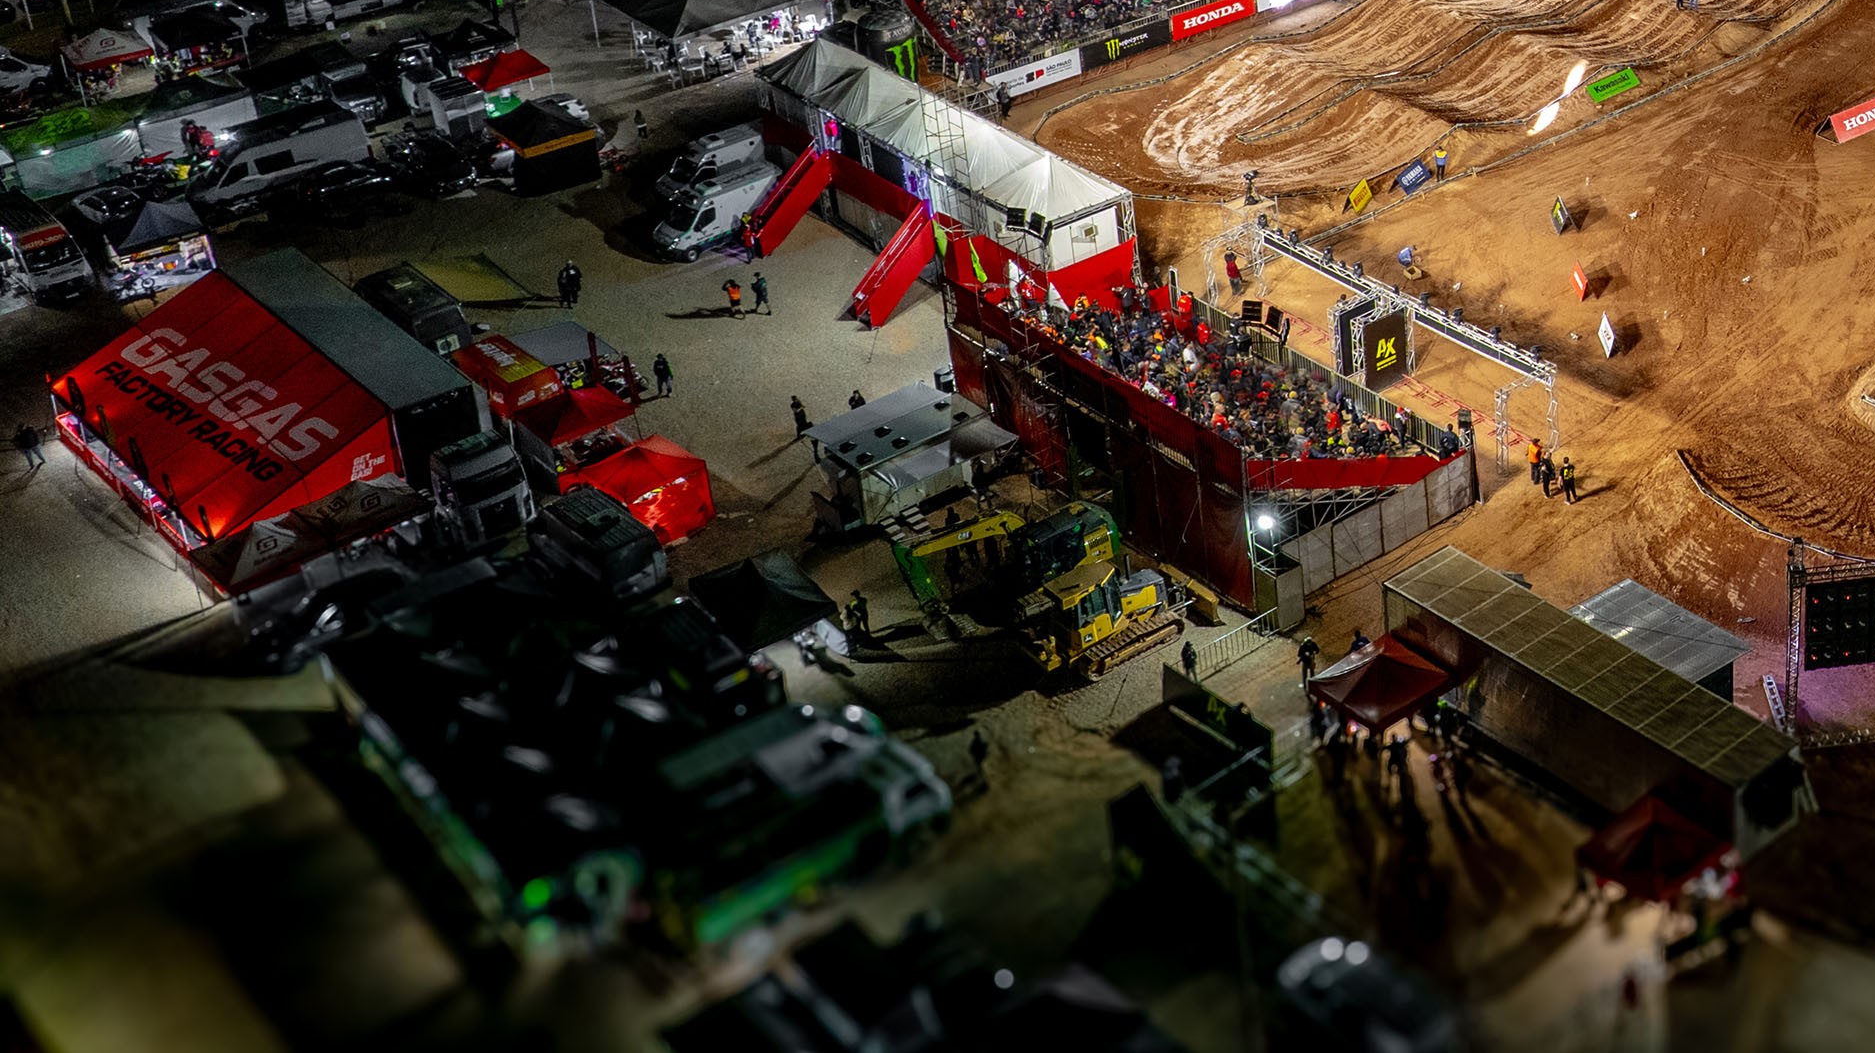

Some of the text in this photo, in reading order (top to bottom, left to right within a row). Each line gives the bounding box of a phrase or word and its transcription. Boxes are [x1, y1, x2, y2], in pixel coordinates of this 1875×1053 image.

[1182, 1, 1245, 31] HONDA
[1593, 72, 1630, 94] Kawasaki
[1375, 336, 1397, 359] AX
[120, 327, 340, 462] GASGAS
[95, 361, 201, 426] FACTORY
[187, 419, 284, 482] RACING
[352, 454, 386, 473] ON THE
[353, 452, 372, 466] GET
